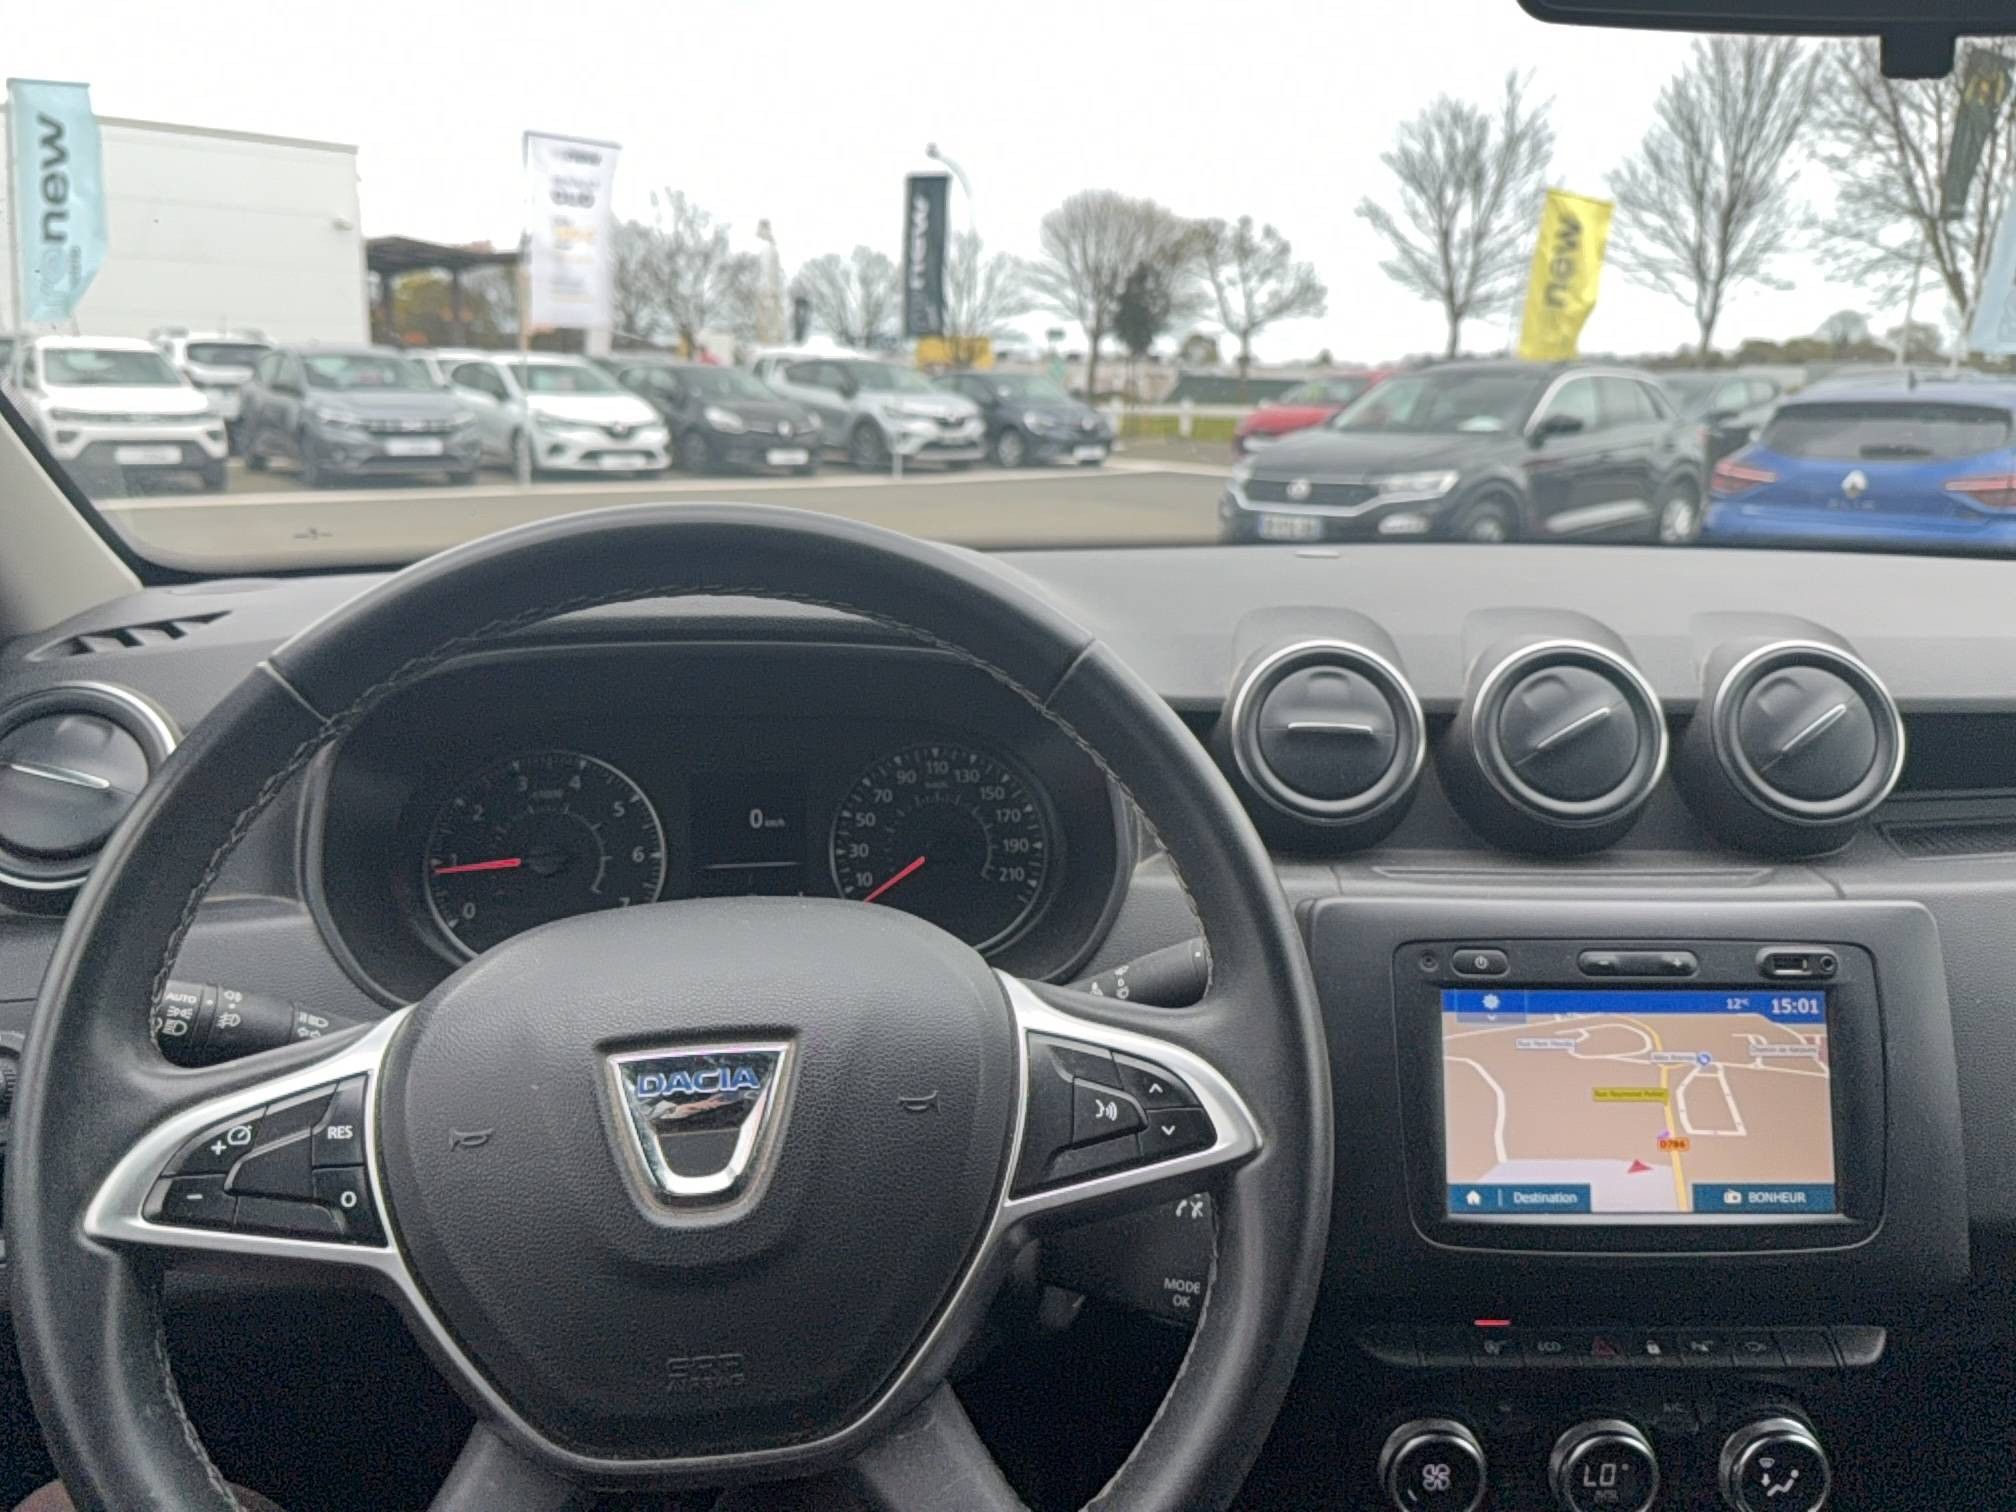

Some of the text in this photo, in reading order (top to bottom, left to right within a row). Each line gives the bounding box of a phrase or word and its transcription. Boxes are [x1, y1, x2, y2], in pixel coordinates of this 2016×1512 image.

[36, 110, 70, 244] new
[1544, 212, 1582, 309] new
[927, 760, 949, 775] 110
[569, 775, 581, 790] 4
[896, 769, 917, 785] 90
[955, 769, 980, 784] 130
[873, 788, 893, 803] 70
[980, 786, 1005, 801] 150
[473, 804, 484, 822] 2
[613, 801, 625, 817] 5
[996, 807, 1022, 823] 170
[749, 808, 763, 829] 0
[855, 812, 876, 827] 50
[849, 843, 869, 858] 30
[1003, 838, 1029, 852] 190
[632, 846, 645, 863] 6
[856, 872, 873, 887] 10
[1000, 867, 1024, 882] 210
[462, 903, 476, 918] 0
[165, 992, 197, 1004] AUTO
[1771, 997, 1819, 1014] 15:01
[637, 1066, 761, 1099] DACIA
[327, 1126, 353, 1139] RES
[1513, 1191, 1577, 1204] Destination
[1748, 1190, 1806, 1204] BONHEUR
[1164, 1277, 1200, 1294] MODE
[1172, 1294, 1191, 1309] OK
